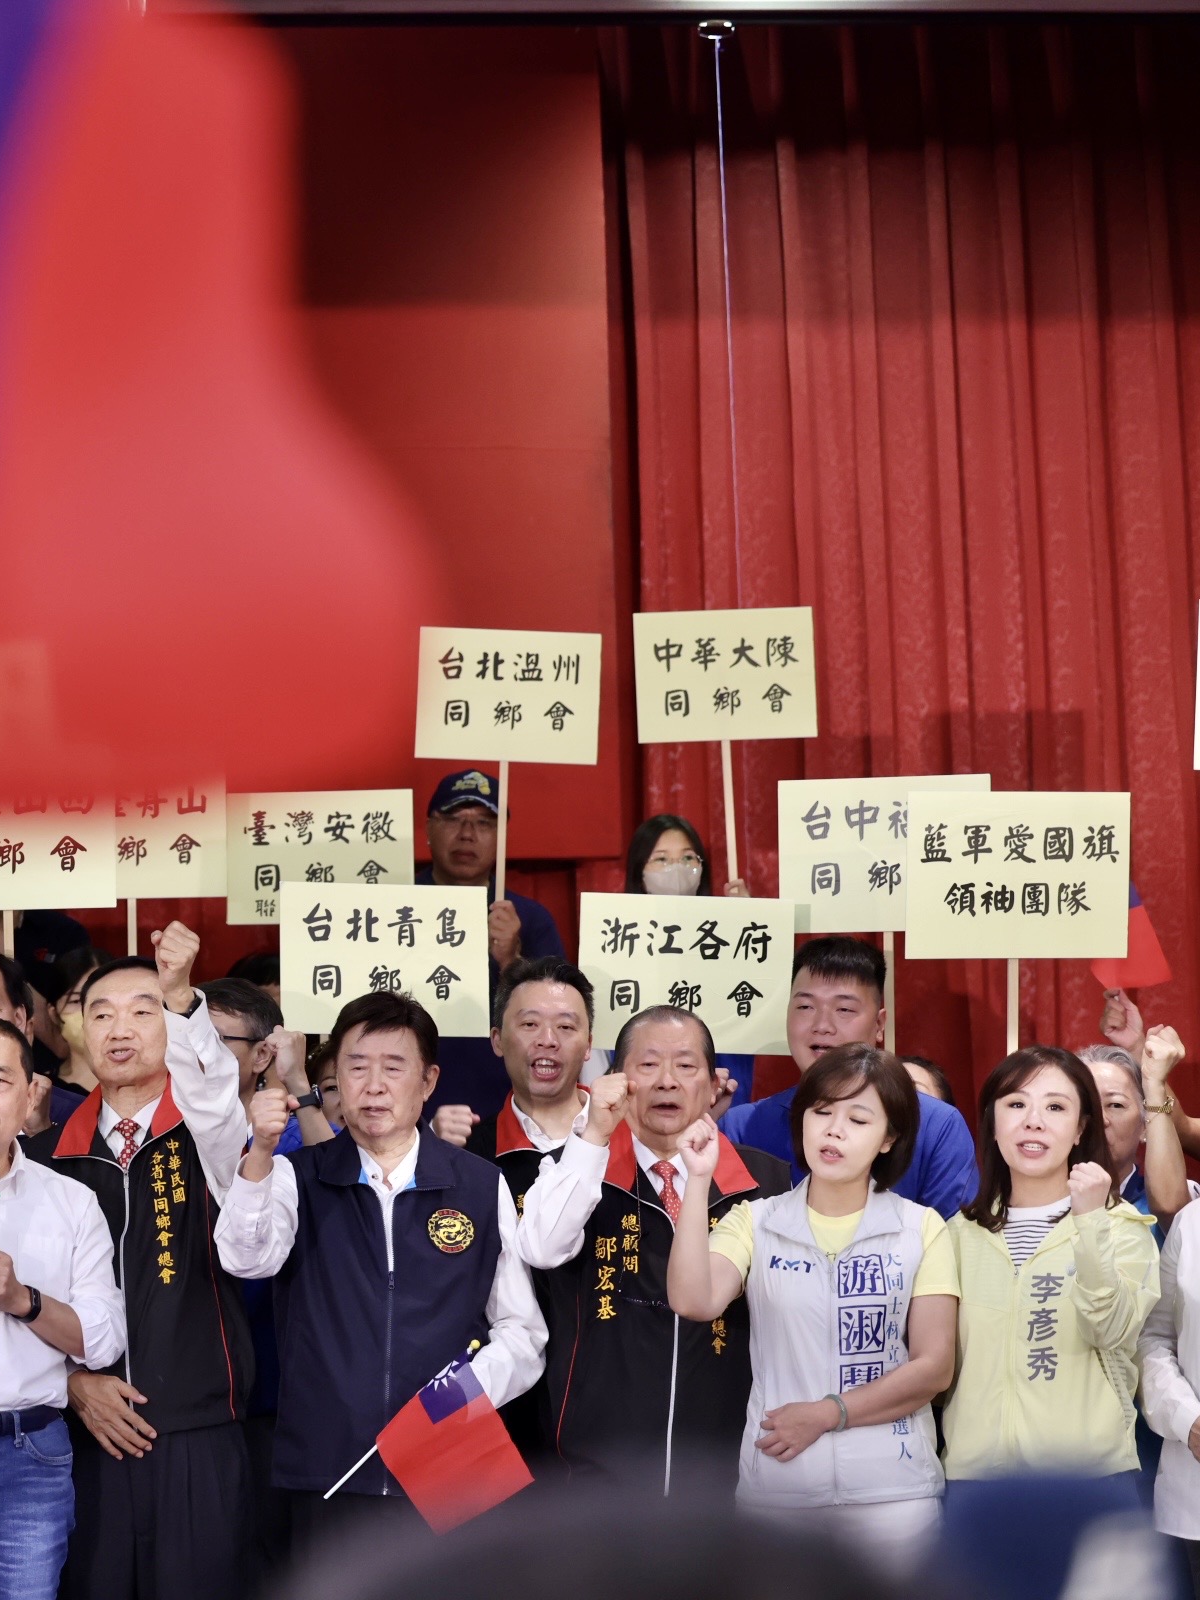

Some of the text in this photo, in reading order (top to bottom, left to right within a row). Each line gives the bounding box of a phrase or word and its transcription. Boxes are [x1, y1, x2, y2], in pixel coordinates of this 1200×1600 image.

[438, 647, 580, 684] 台北溫州
[653, 635, 799, 673] 中華大陳
[444, 700, 575, 732] 同鄉會
[664, 683, 792, 717] 同鄉會
[244, 810, 398, 846] 臺灣安徽
[921, 823, 1120, 864] 藍軍愛國旗
[943, 880, 1092, 917] 領袖團隊
[302, 903, 466, 948] 台北青島
[601, 917, 772, 964] 浙江各府
[312, 964, 462, 1001] 同鄉會
[609, 979, 764, 1018] 同鄉會
[165, 1138, 186, 1204] 中華民國
[621, 1213, 640, 1274] 總顧問
[594, 1236, 618, 1320] 鄒宏基
[770, 1255, 816, 1273] KMT
[1026, 1272, 1065, 1382] 李彥秀
